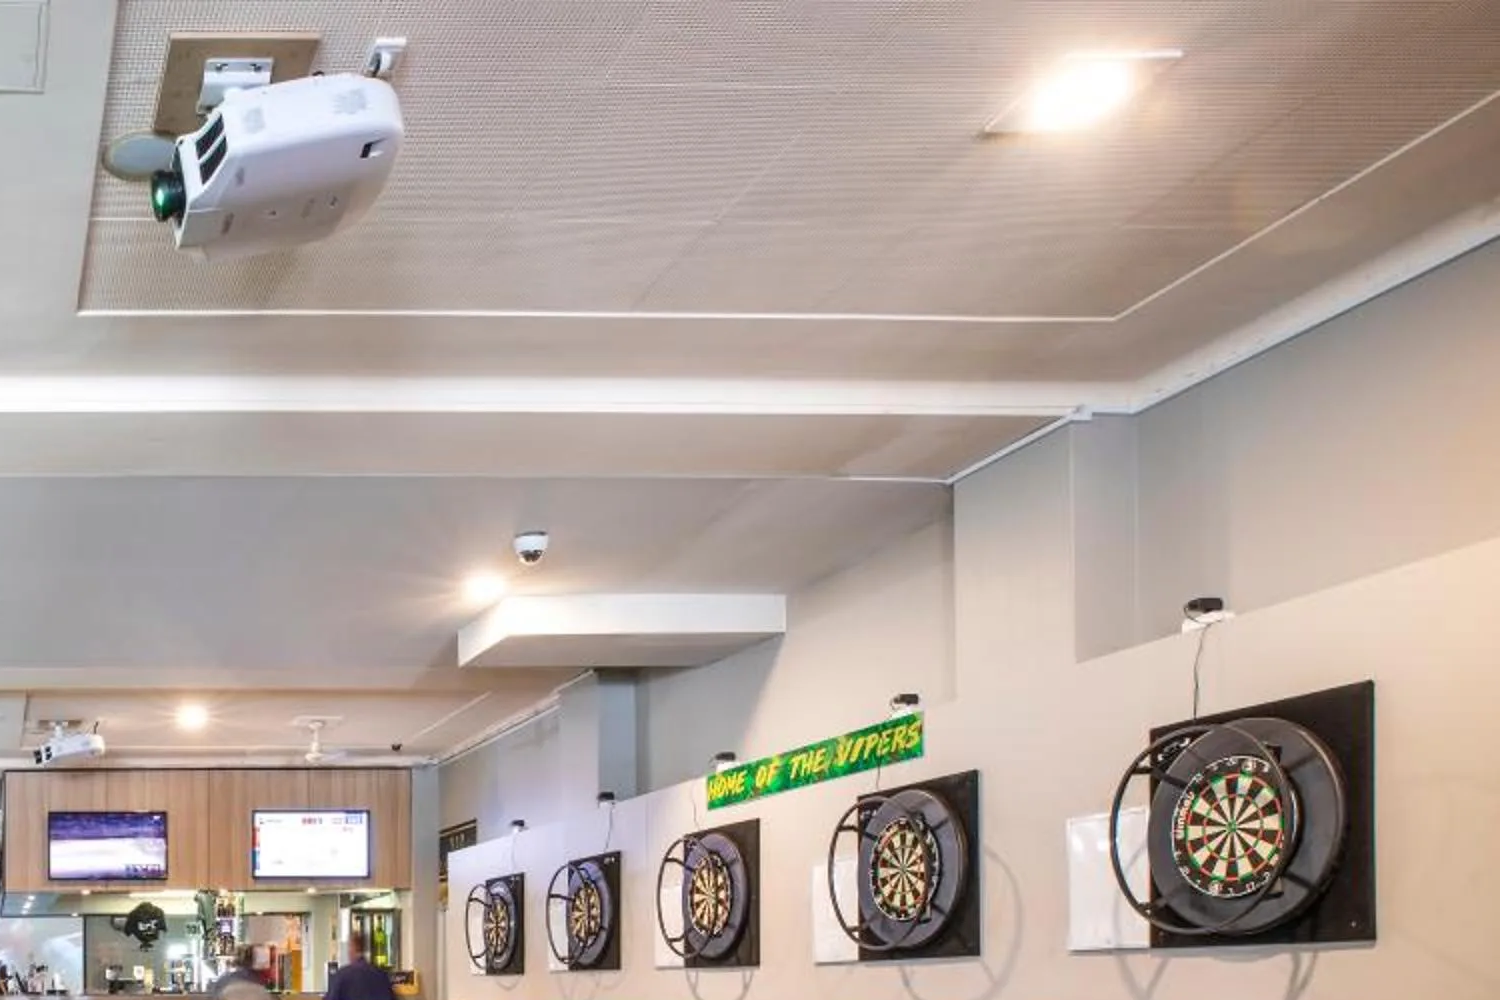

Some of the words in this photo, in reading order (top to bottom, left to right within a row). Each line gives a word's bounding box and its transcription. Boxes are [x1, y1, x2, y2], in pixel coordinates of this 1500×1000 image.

[708, 769, 747, 801] HOME
[755, 758, 780, 788] OF
[790, 749, 827, 780] THE
[836, 722, 921, 766] VIPERS
